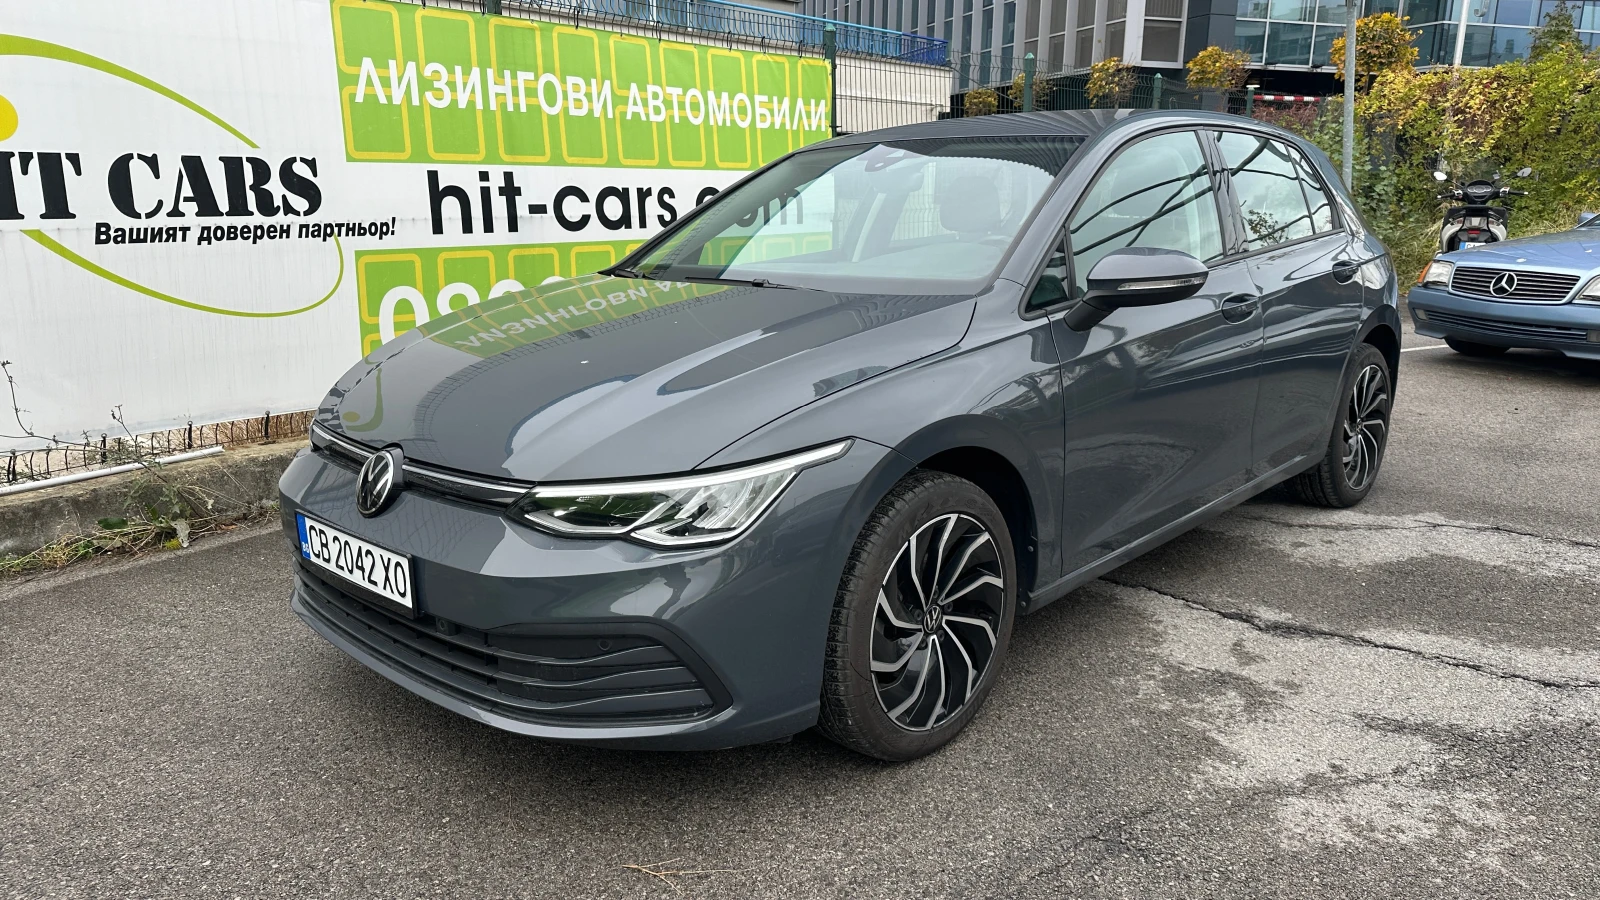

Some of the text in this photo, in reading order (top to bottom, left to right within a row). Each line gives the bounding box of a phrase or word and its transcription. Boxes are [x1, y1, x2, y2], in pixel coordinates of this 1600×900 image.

[355, 57, 827, 132] ЛИЗИНГОВИ АВТОМОБИЛИ
[107, 152, 322, 219] CARS
[94, 217, 396, 245] Вашият доверен партньор!
[308, 524, 407, 599] CB 2042 XO
